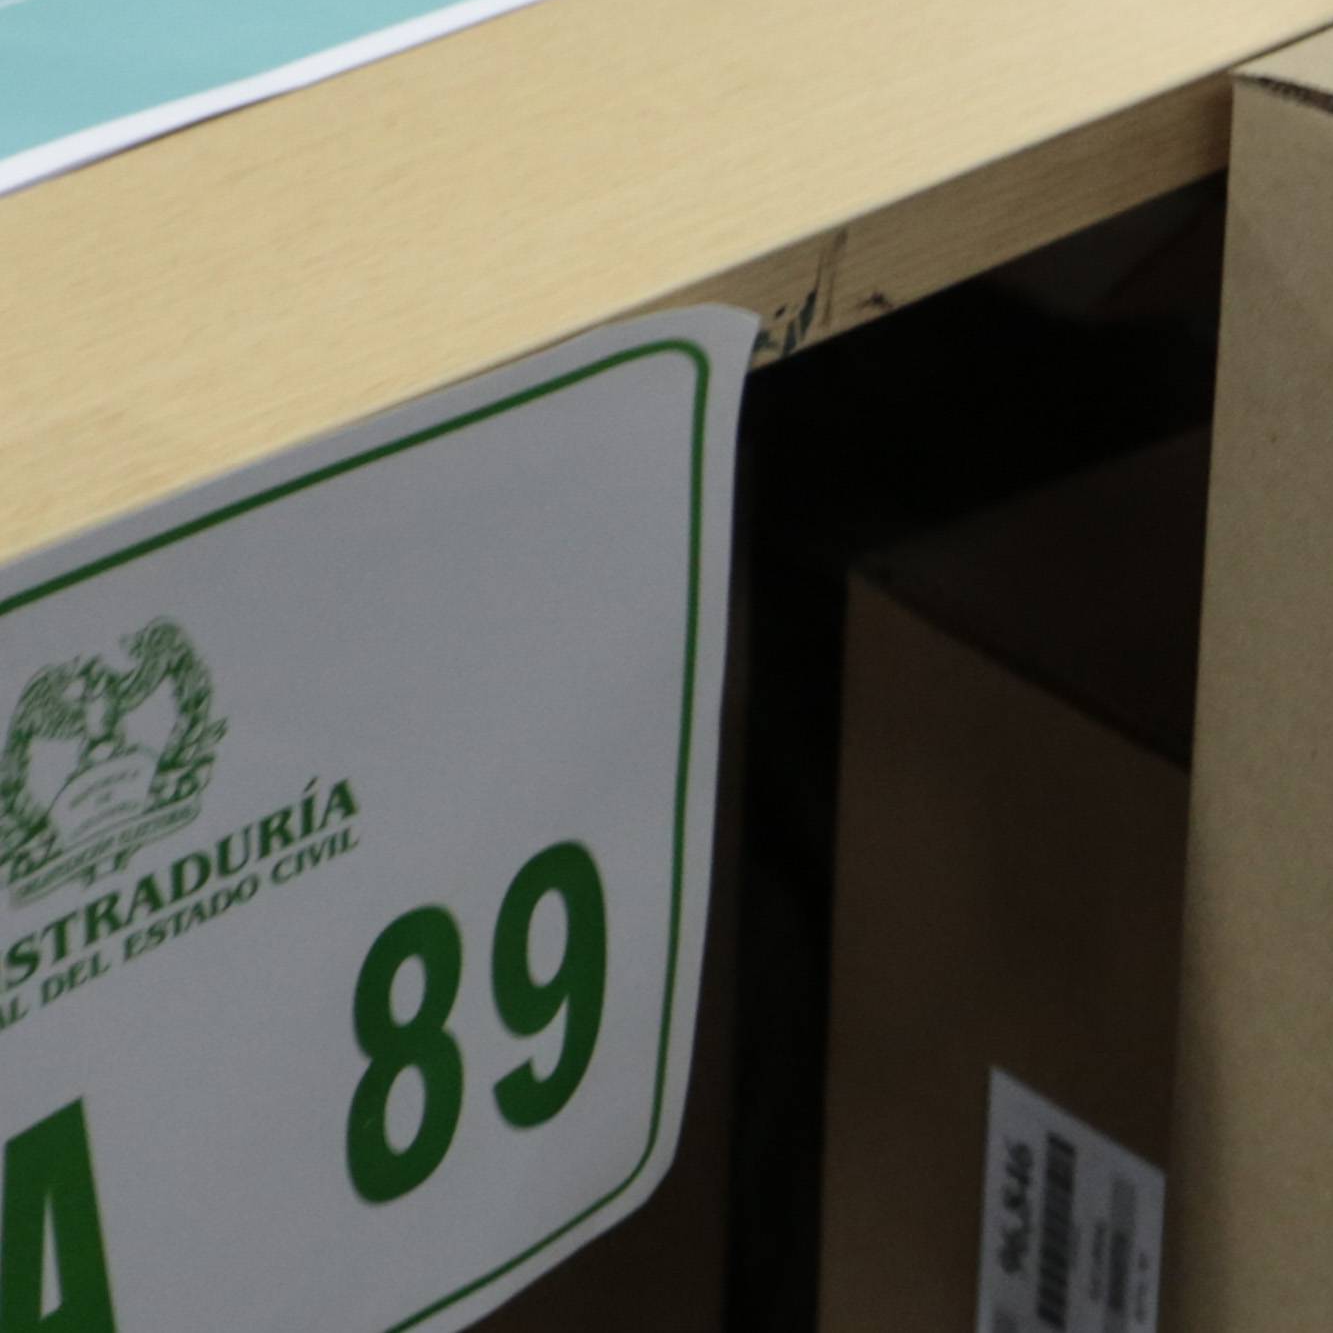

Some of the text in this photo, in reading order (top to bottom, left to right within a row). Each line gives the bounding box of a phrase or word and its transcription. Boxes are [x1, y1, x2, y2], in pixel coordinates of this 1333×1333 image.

[38, 950, 113, 1009] DEL
[122, 871, 261, 964] ESTADO
[269, 826, 362, 887] CIVIL
[346, 837, 608, 1206] 89
